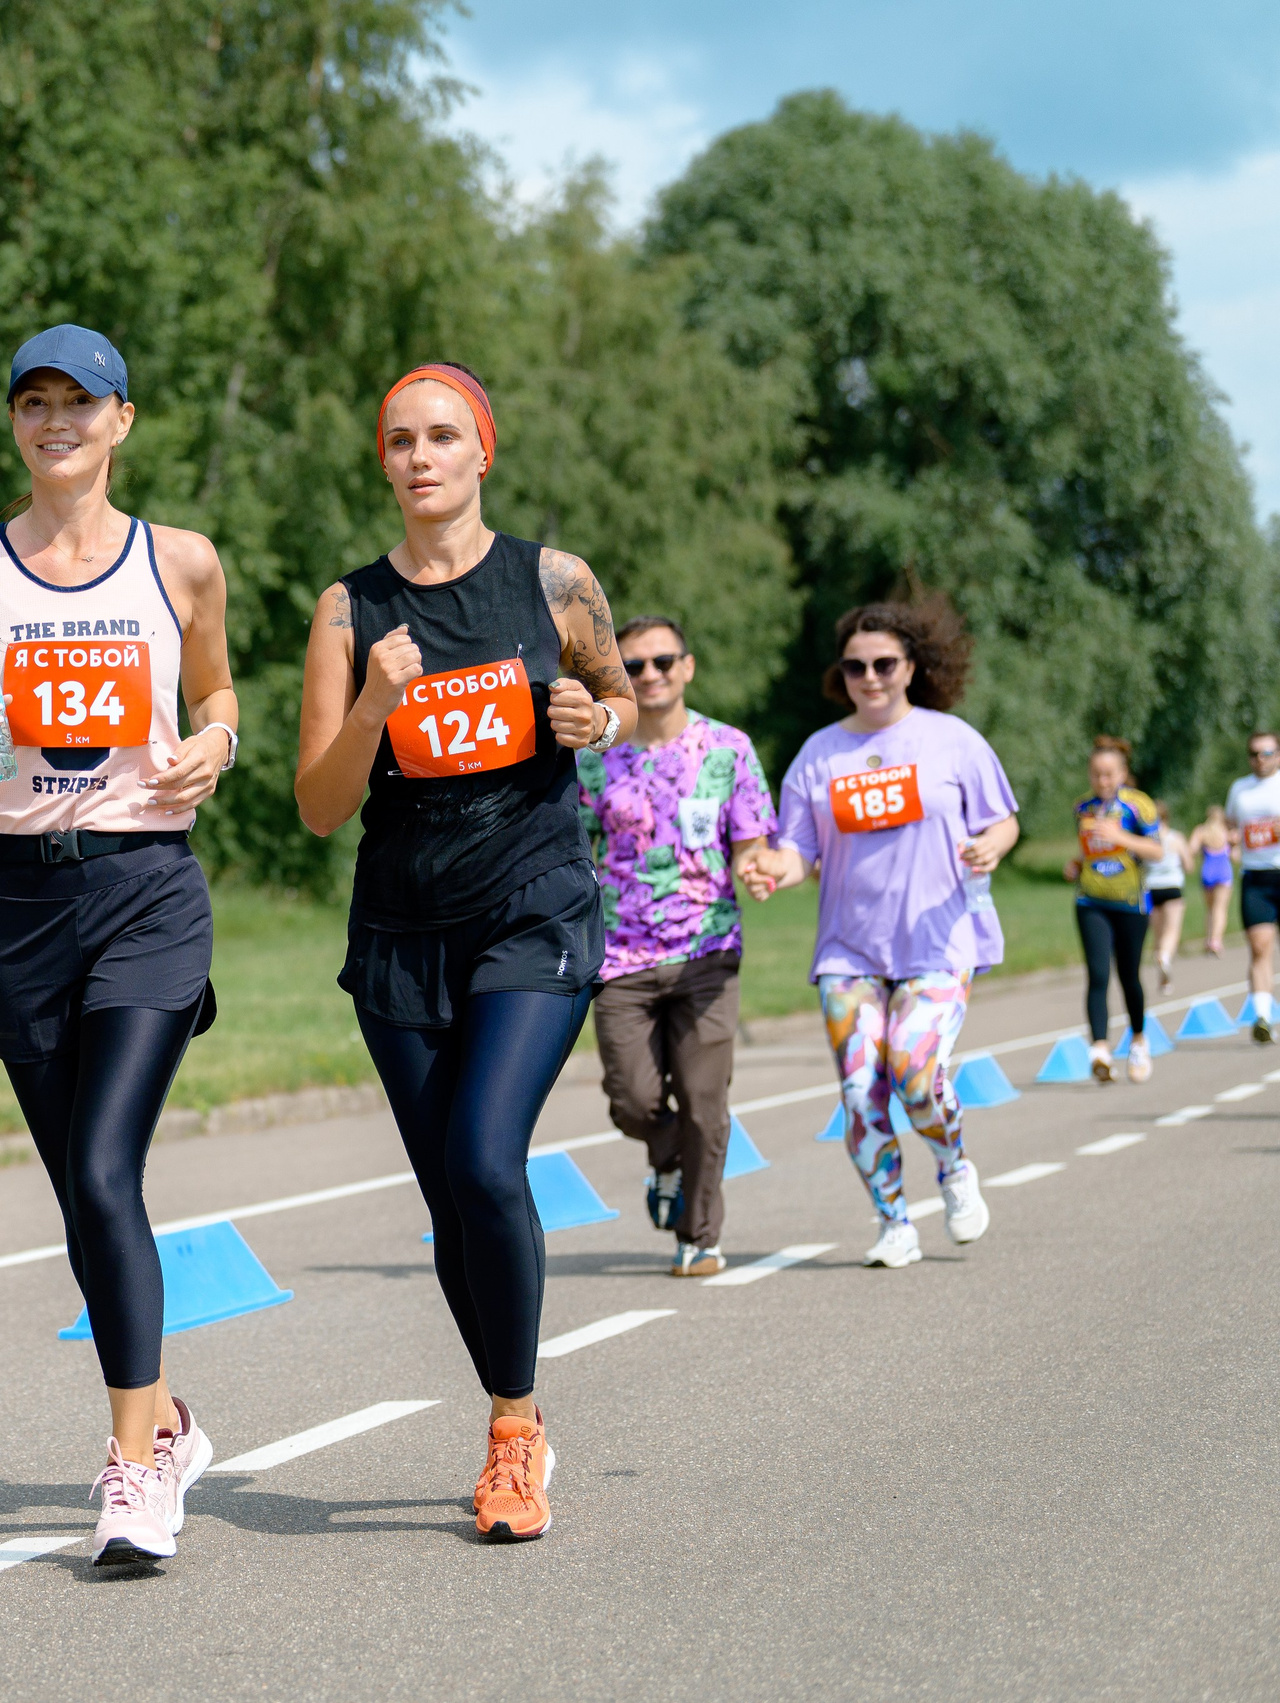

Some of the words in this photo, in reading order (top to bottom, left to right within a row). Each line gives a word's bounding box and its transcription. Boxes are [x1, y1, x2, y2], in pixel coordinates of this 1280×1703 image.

[10, 622, 56, 641] THE
[62, 619, 140, 637] BRAND
[14, 648, 28, 667] Я
[33, 648, 49, 667] С
[53, 644, 140, 668] ТОБОЙ
[412, 685, 429, 703] С
[431, 663, 517, 699] ТОБОЙ
[33, 680, 125, 726] 134
[65, 733, 72, 744] 5
[417, 703, 511, 758] 124
[458, 761, 466, 771] 5
[32, 775, 109, 795] STRIPES
[848, 783, 905, 821] 185
